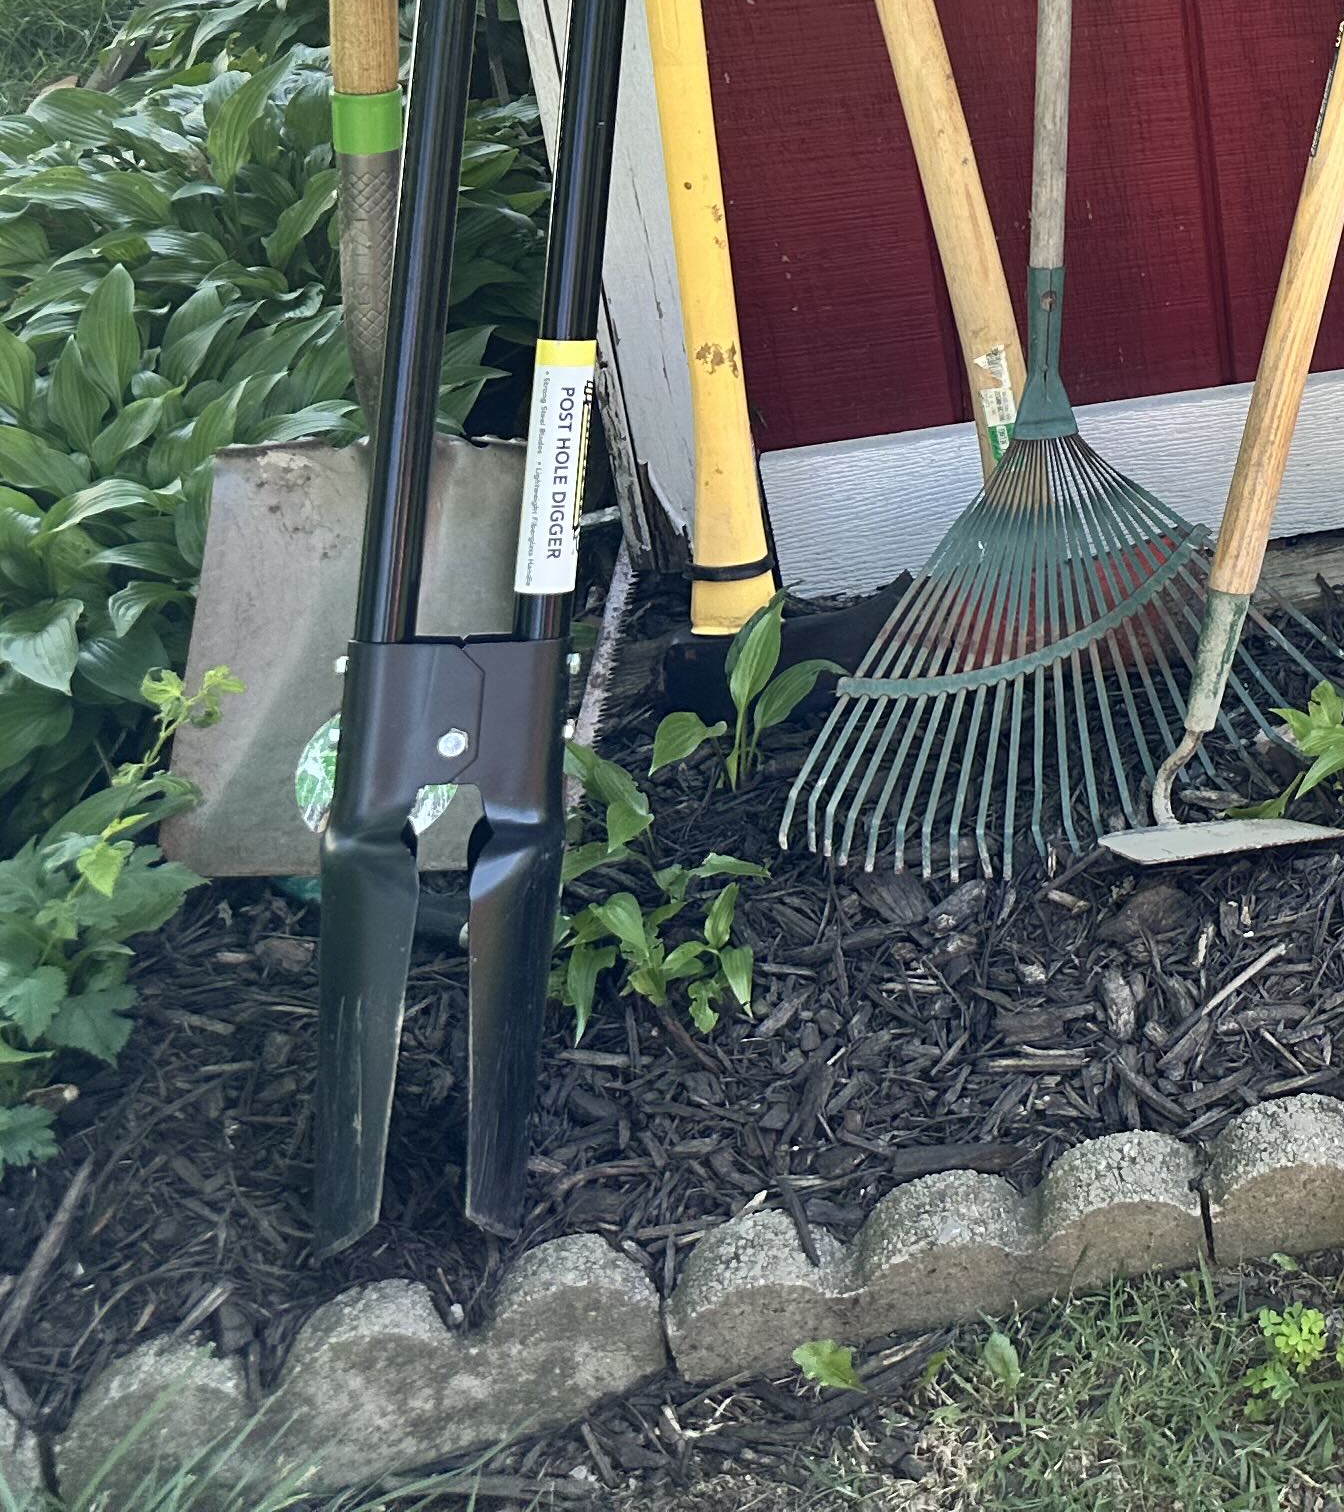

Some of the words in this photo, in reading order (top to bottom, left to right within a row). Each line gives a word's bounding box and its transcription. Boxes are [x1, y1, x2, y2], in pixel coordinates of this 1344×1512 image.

[558, 387, 576, 432] POST
[553, 438, 571, 485] HOLE
[546, 491, 567, 559] DIGGER
